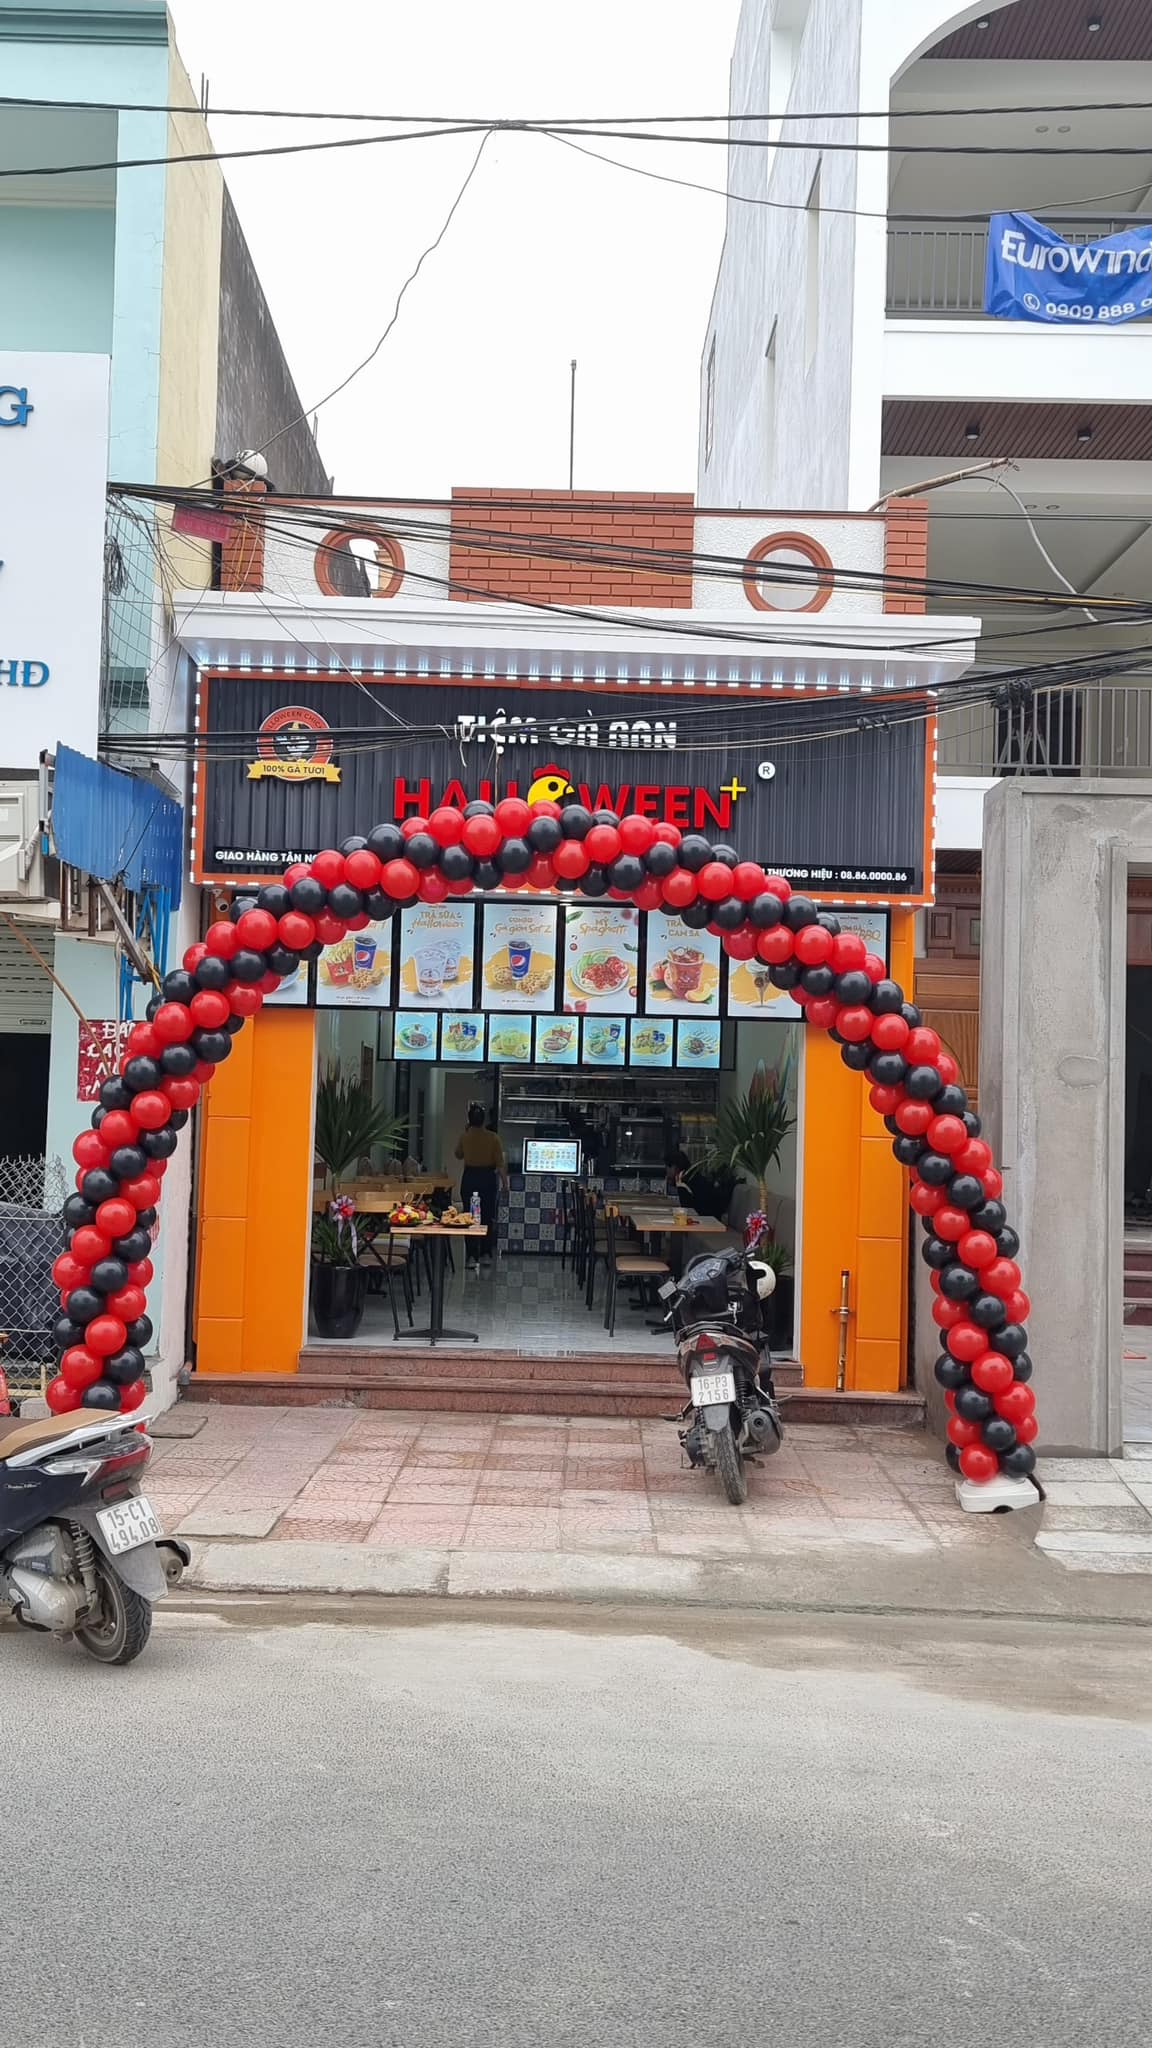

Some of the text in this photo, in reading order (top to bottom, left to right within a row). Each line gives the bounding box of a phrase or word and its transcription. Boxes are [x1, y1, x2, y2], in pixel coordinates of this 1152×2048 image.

[1046, 303, 1136, 319] 0909 888
[263, 765, 285, 773] 100%
[215, 851, 244, 860] GIAO
[246, 850, 279, 862] HÀNG
[280, 851, 302, 864] TẬN
[767, 867, 809, 878] THƯƠNG
[811, 868, 833, 880] HIỆU
[698, 1390, 729, 1403] 2156
[107, 1500, 147, 1529] 15-C1
[111, 1517, 159, 1550] 494.08
